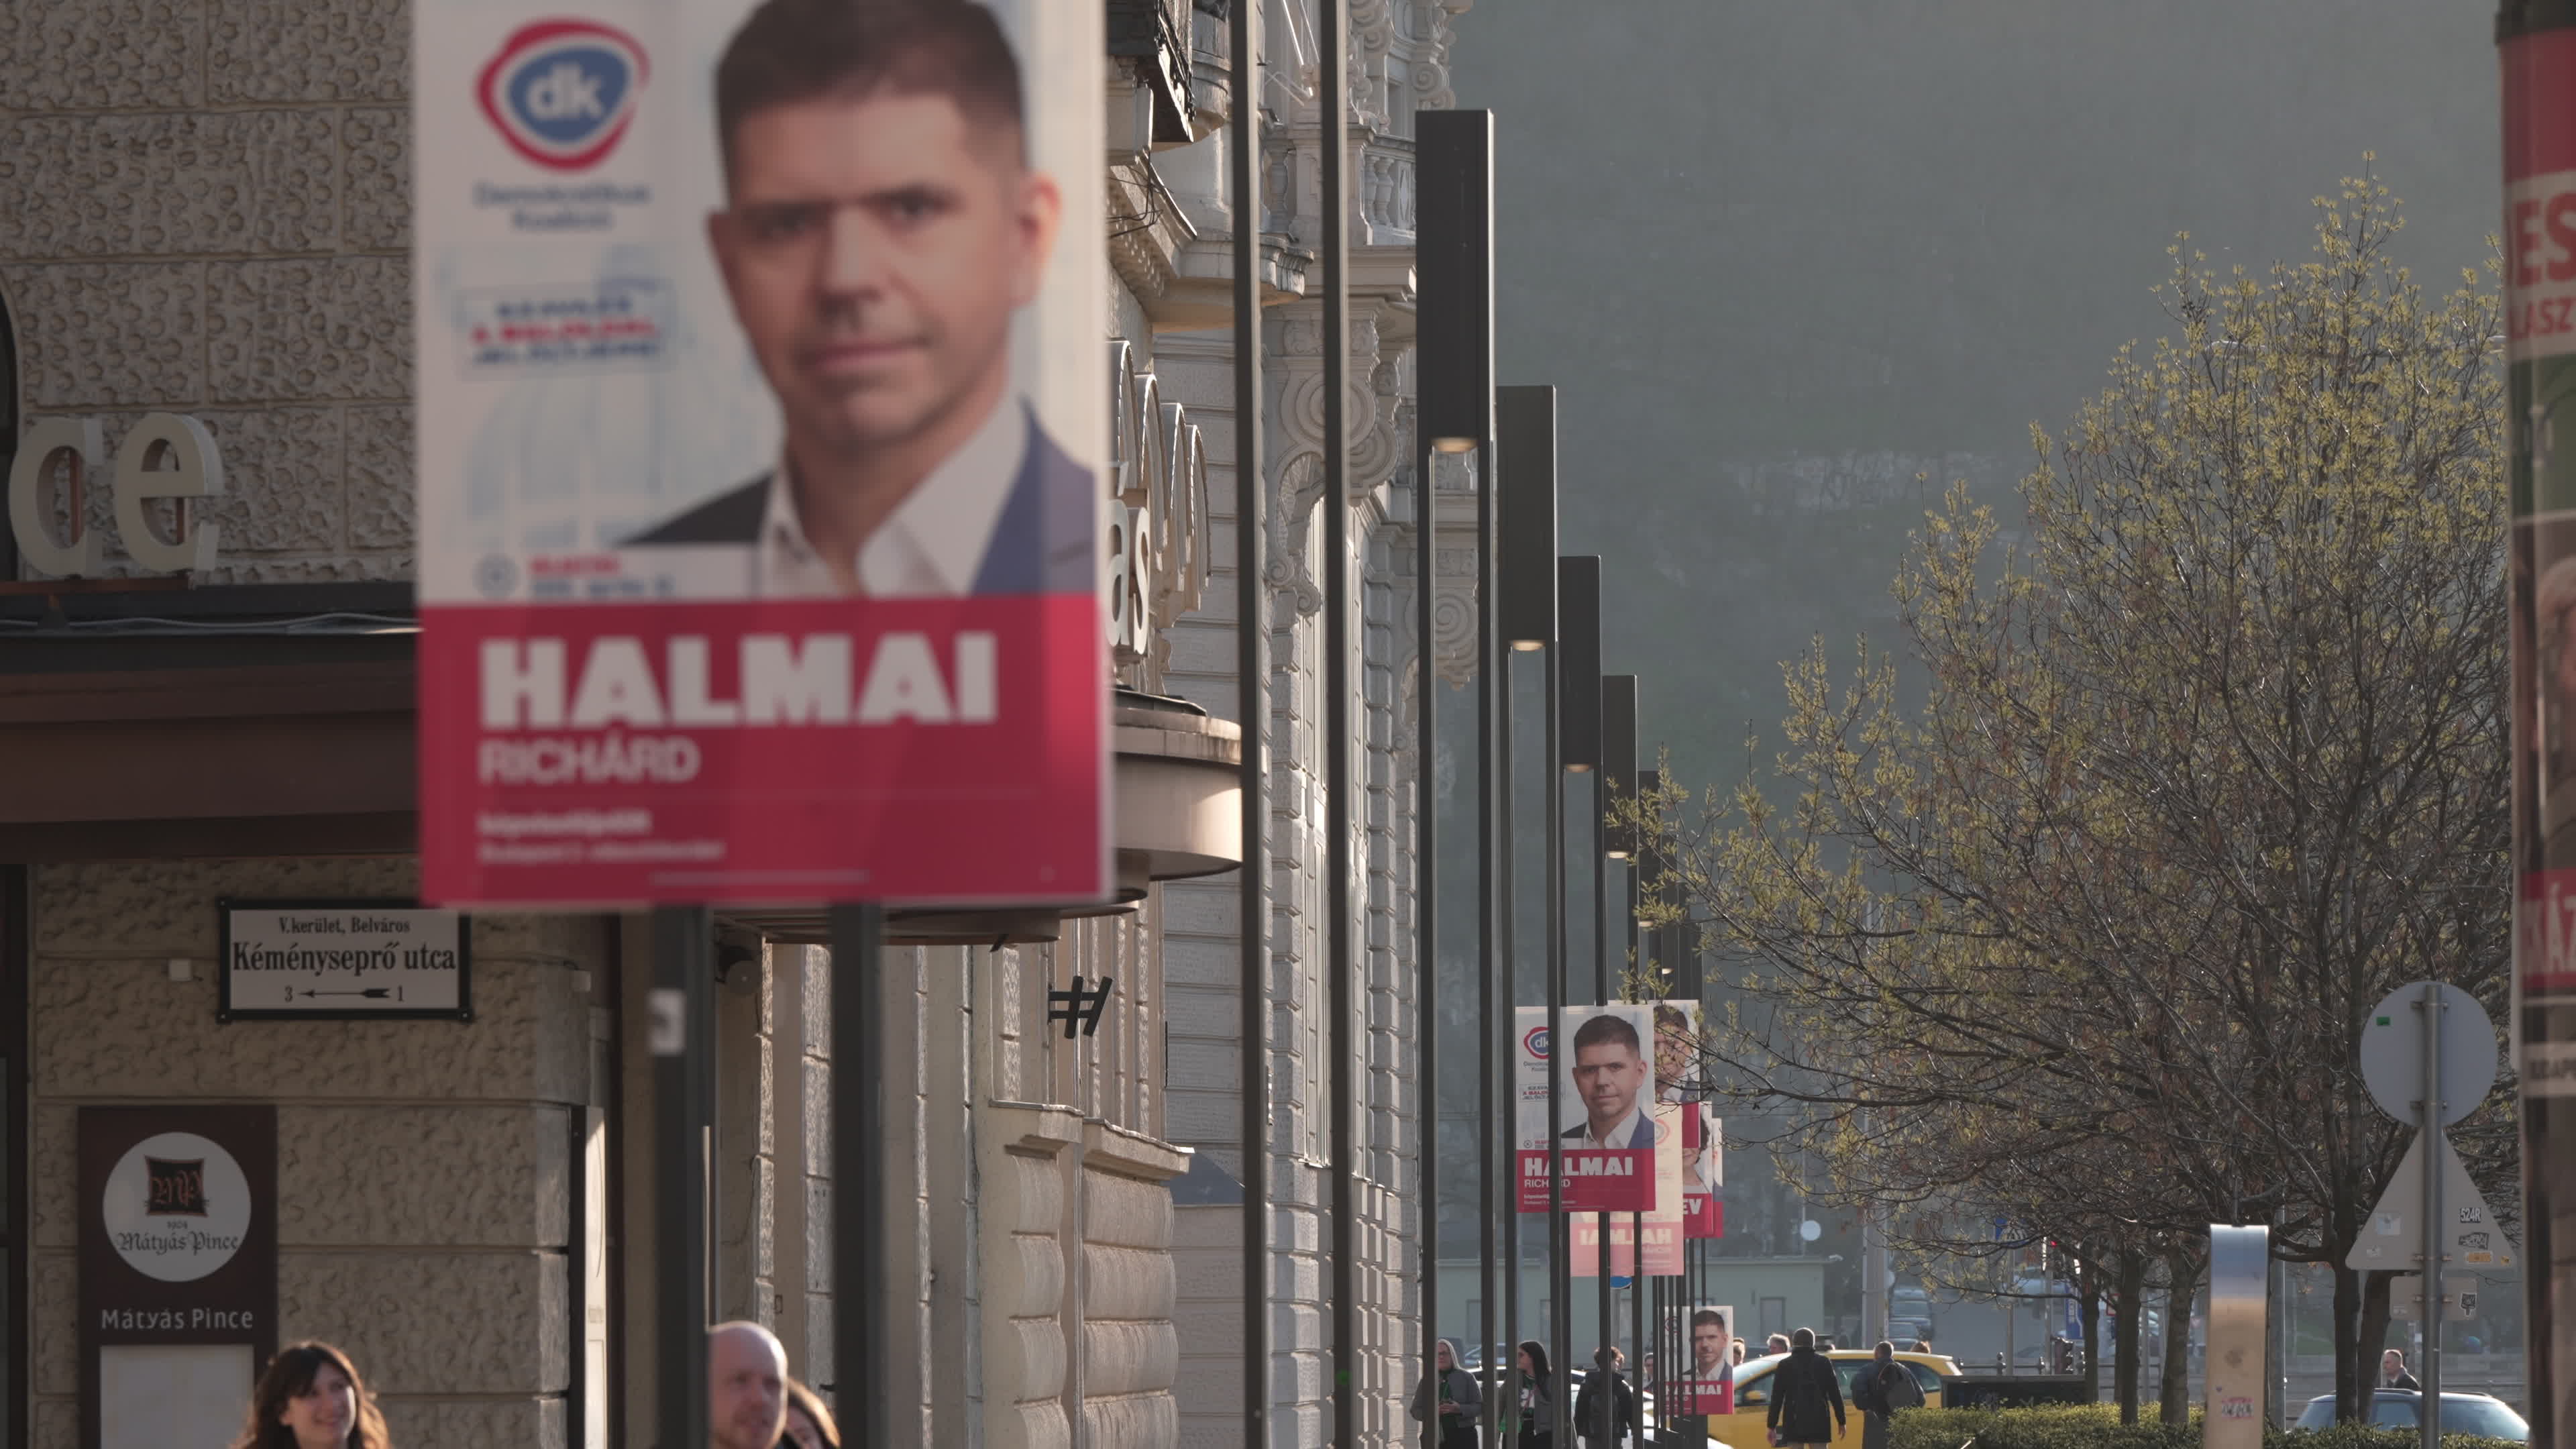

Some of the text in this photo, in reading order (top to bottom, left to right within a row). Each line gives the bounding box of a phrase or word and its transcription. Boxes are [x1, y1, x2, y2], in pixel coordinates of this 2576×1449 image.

[527, 64, 605, 120] dk
[481, 633, 997, 730] HALMAI
[478, 731, 701, 784] RICHÁRD
[351, 917, 410, 933] Belváros
[233, 941, 457, 976] Kéményseprő utca
[284, 985, 404, 1002] 3 1
[116, 1230, 239, 1256] Mátyás Pince
[101, 1308, 254, 1329] Mátyás Pince
